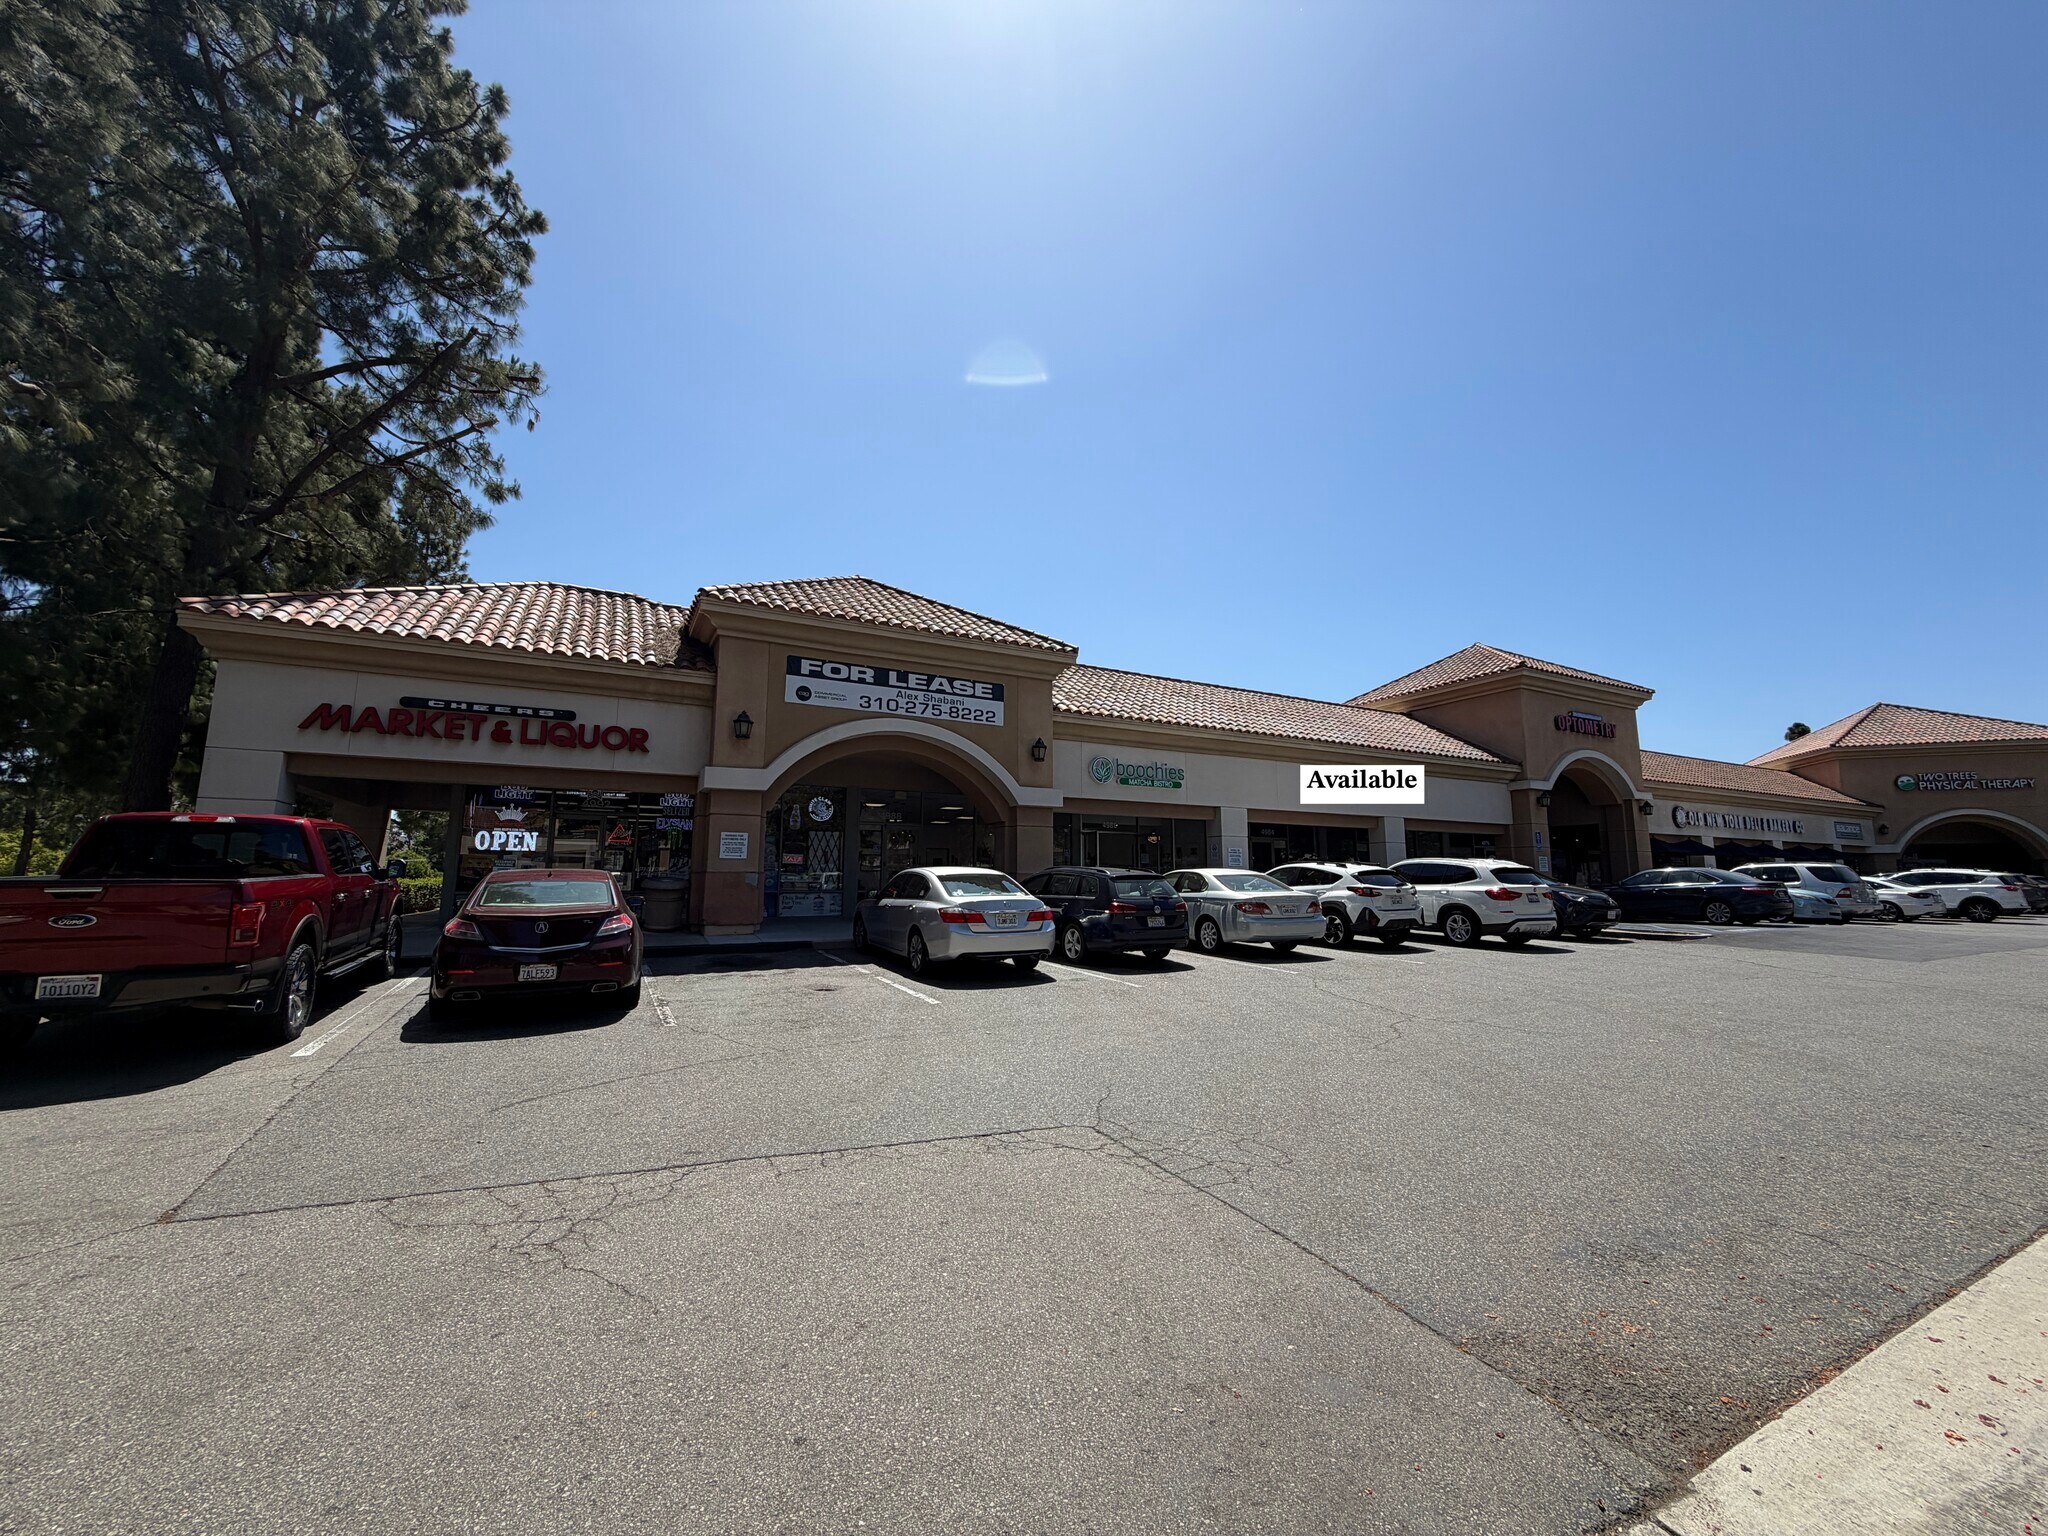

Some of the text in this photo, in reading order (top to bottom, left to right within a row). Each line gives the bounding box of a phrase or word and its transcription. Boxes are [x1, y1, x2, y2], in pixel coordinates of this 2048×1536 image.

[801, 659, 994, 699] FOR LEASE
[814, 690, 847, 698] COMMERCIAL
[896, 690, 965, 707] Alex Shabani
[428, 699, 554, 717] CHEERS
[859, 695, 996, 723] 310-275-8222
[297, 703, 650, 753] MARKET & LIQUOR
[1555, 715, 1617, 738] OPTOMETRY
[1116, 758, 1185, 781] boochies
[1918, 772, 1978, 781] TWO TREES
[1128, 778, 1174, 788] MATCHA BISTRO
[1919, 778, 2035, 791] PHYSICAL THERAPY
[494, 789, 534, 800] LIGHT
[659, 797, 695, 807] LIGHT
[656, 817, 694, 831] ELYSIAN
[1687, 811, 1703, 826] OLD
[1706, 813, 1722, 827] NEW
[1724, 814, 1744, 829] YORK
[474, 830, 539, 852] OPEN
[521, 967, 555, 980] 7ALF593
[41, 983, 96, 997] 10110Y2
